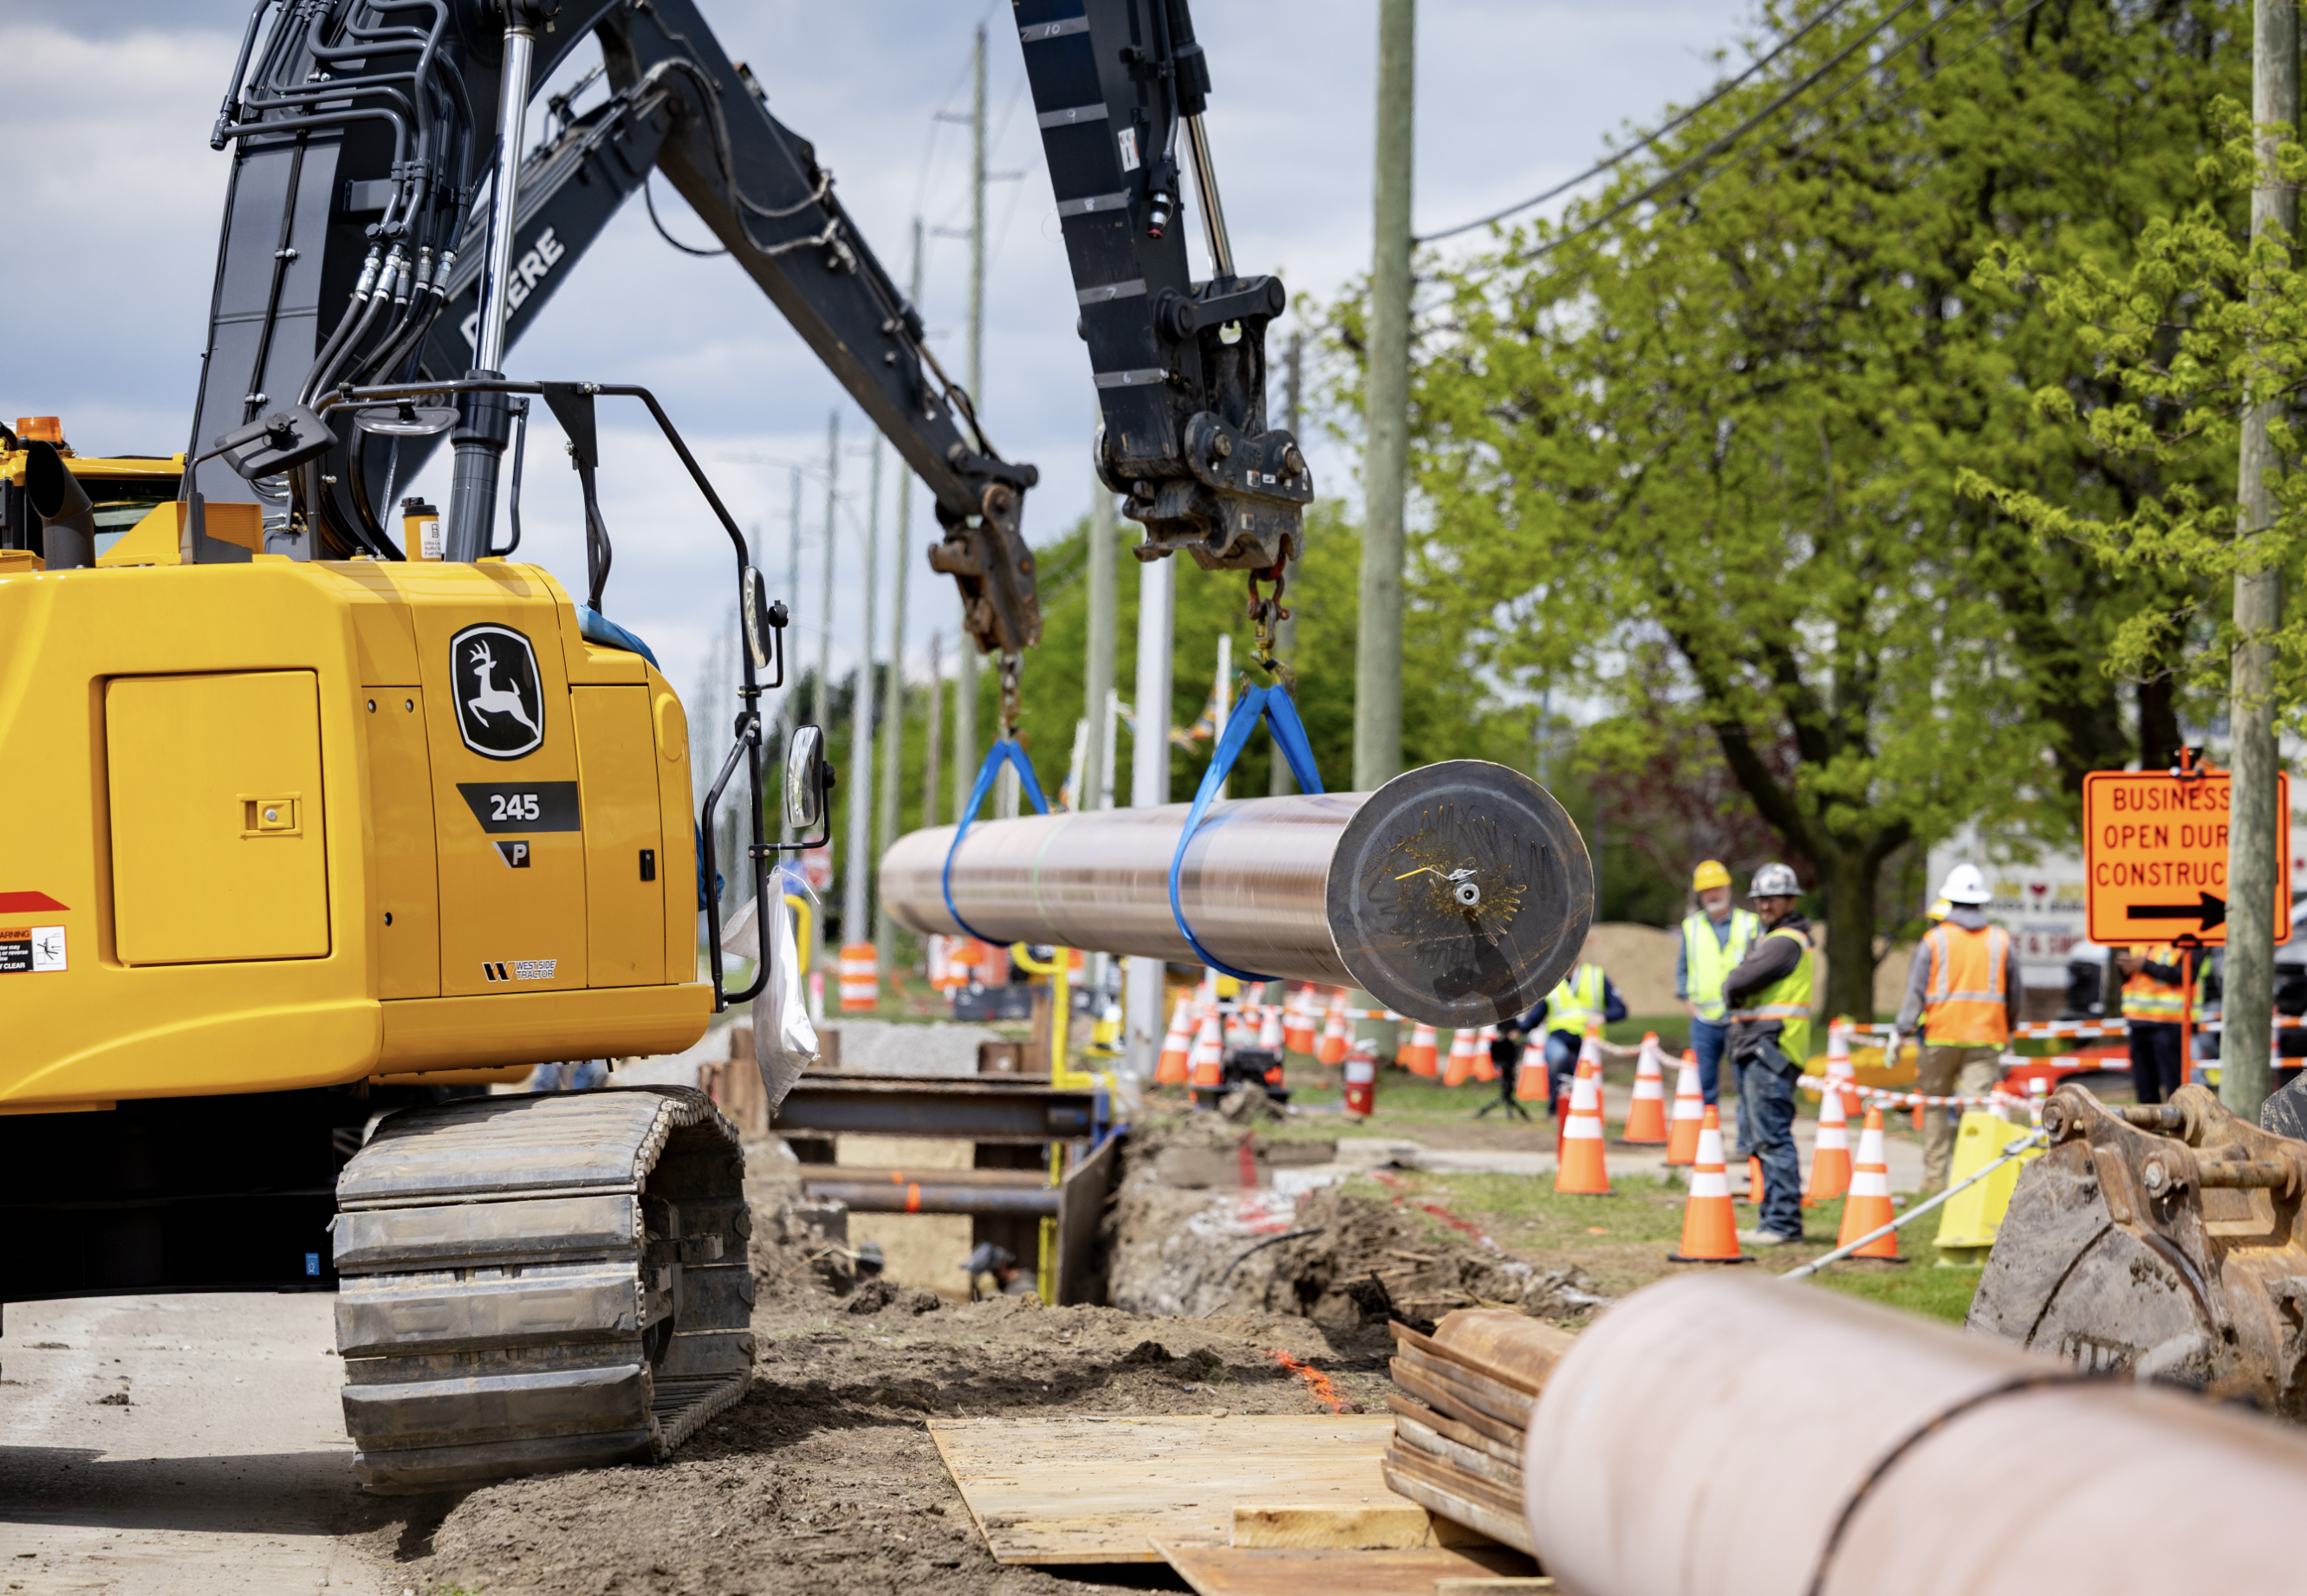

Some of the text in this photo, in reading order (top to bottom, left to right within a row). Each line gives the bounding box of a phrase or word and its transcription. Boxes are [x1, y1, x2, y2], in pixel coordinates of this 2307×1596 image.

[1044, 23, 1061, 36] 10
[1067, 109, 1076, 124] 9
[459, 226, 566, 352] DERE
[1106, 286, 1117, 300] 7
[1122, 373, 1132, 384] 6
[490, 794, 540, 821] 245
[2113, 787, 2231, 811] BUSINESS
[2104, 824, 2229, 849] OPEN DUR
[512, 843, 528, 866] P
[2096, 861, 2226, 886] CONSTRUC
[516, 961, 537, 970] WEST
[538, 960, 556, 969] SIDE
[517, 970, 555, 979] TRACTOR
